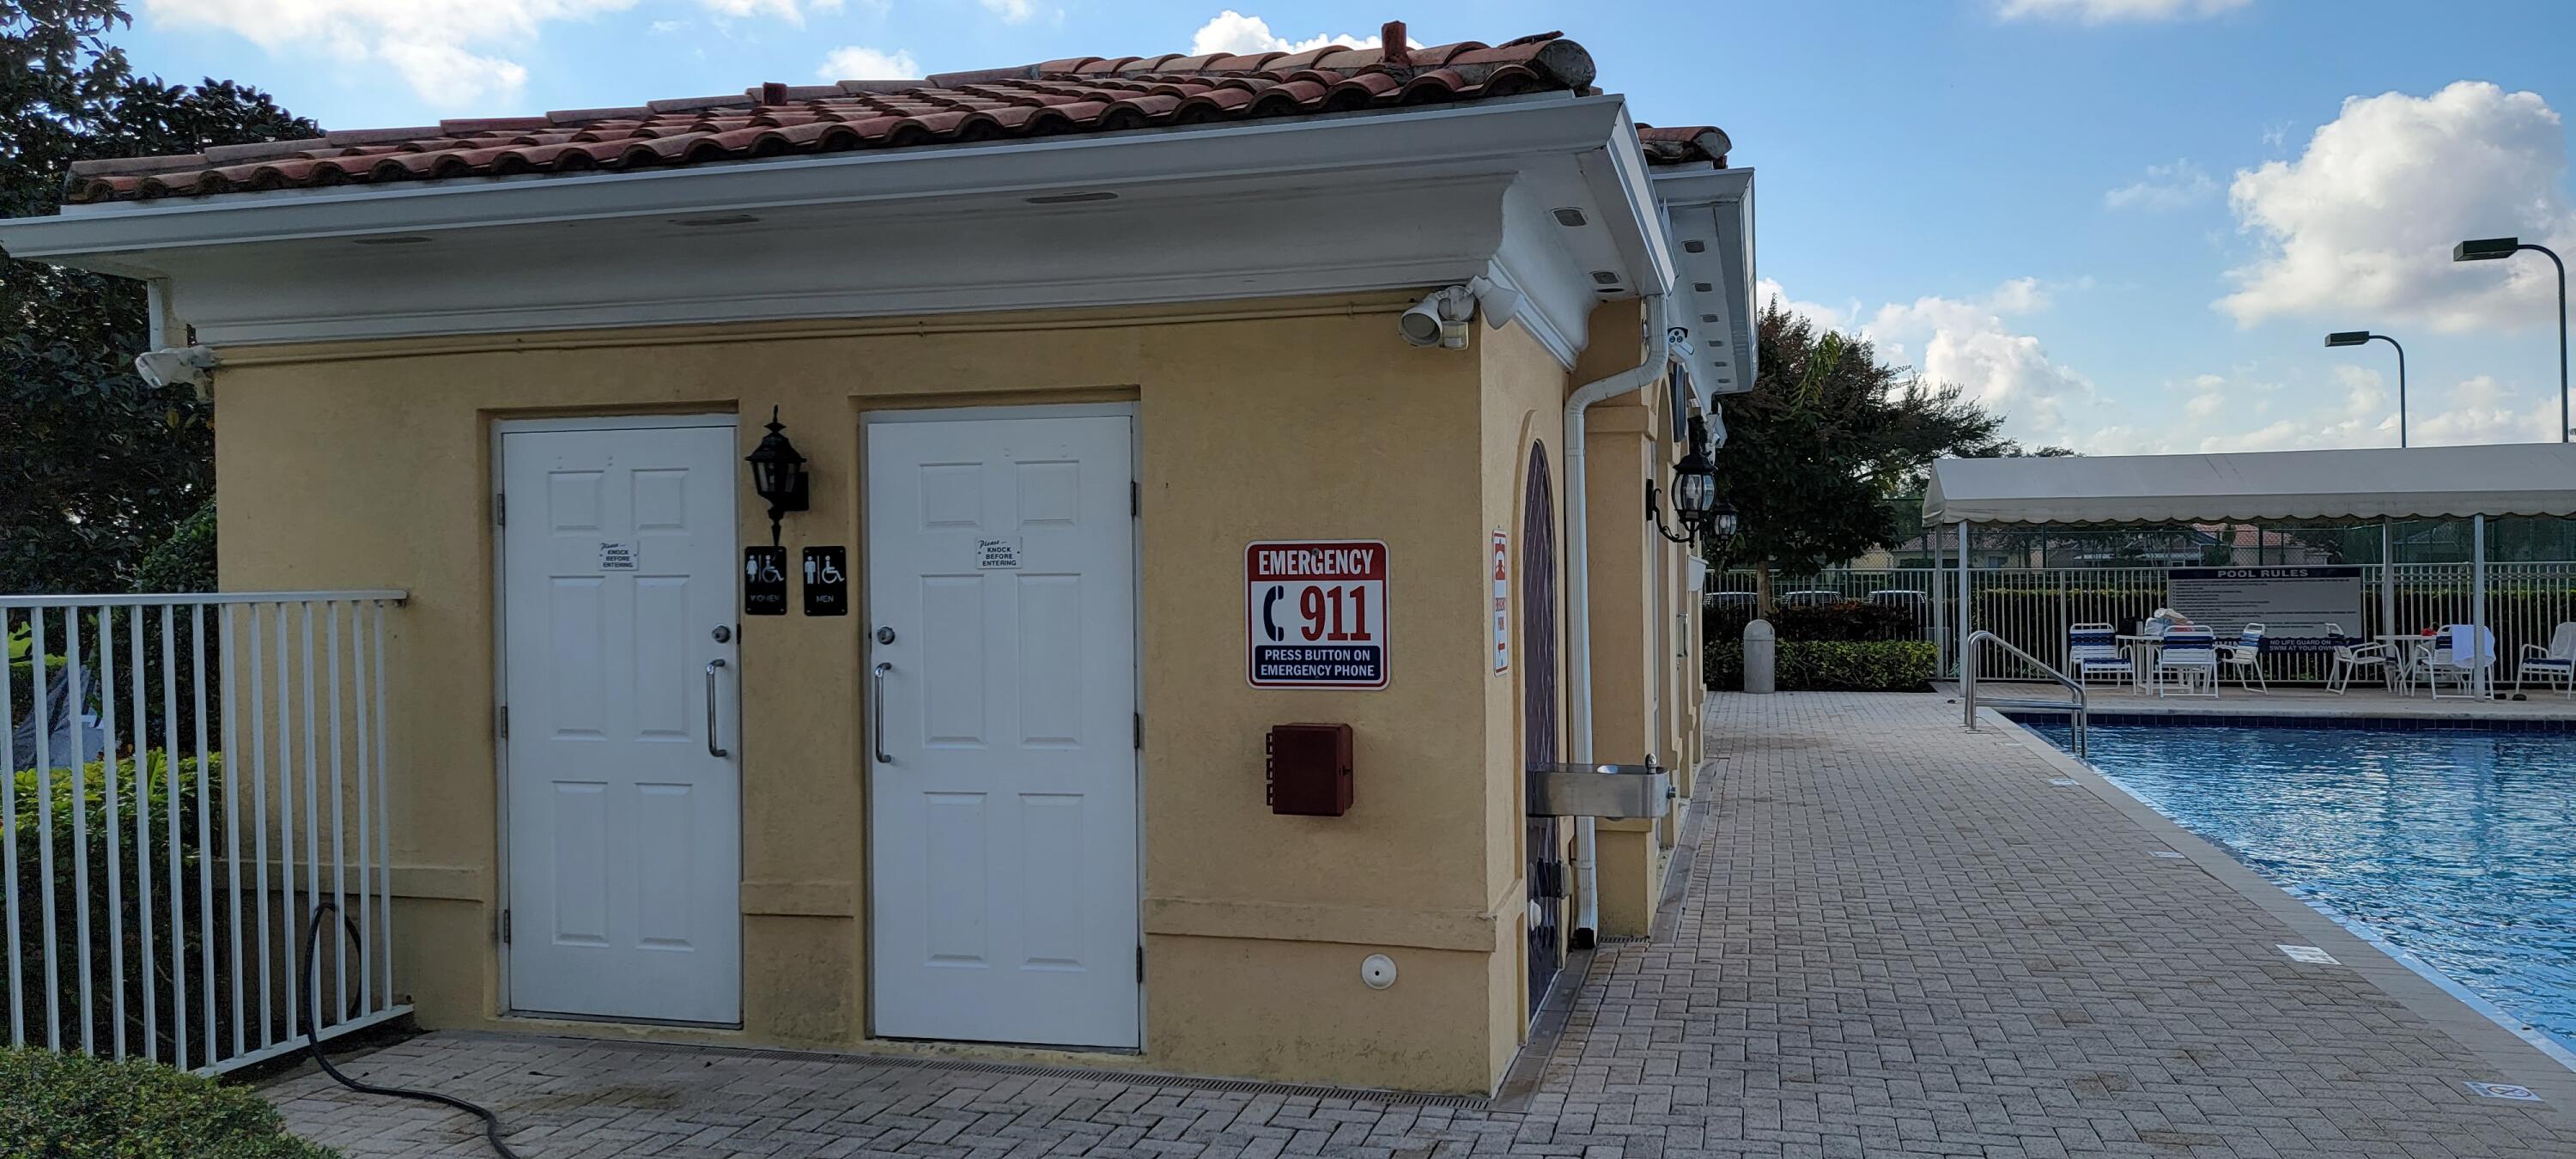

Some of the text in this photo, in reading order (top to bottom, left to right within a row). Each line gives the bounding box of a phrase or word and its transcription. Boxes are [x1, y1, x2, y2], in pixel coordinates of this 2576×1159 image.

[1259, 549, 1374, 575] EMERGENCY
[1300, 586, 1371, 641] 911
[1265, 649, 1370, 661] PRESS BUTTON ON
[1261, 664, 1375, 677] EMERGENCY PHONE
